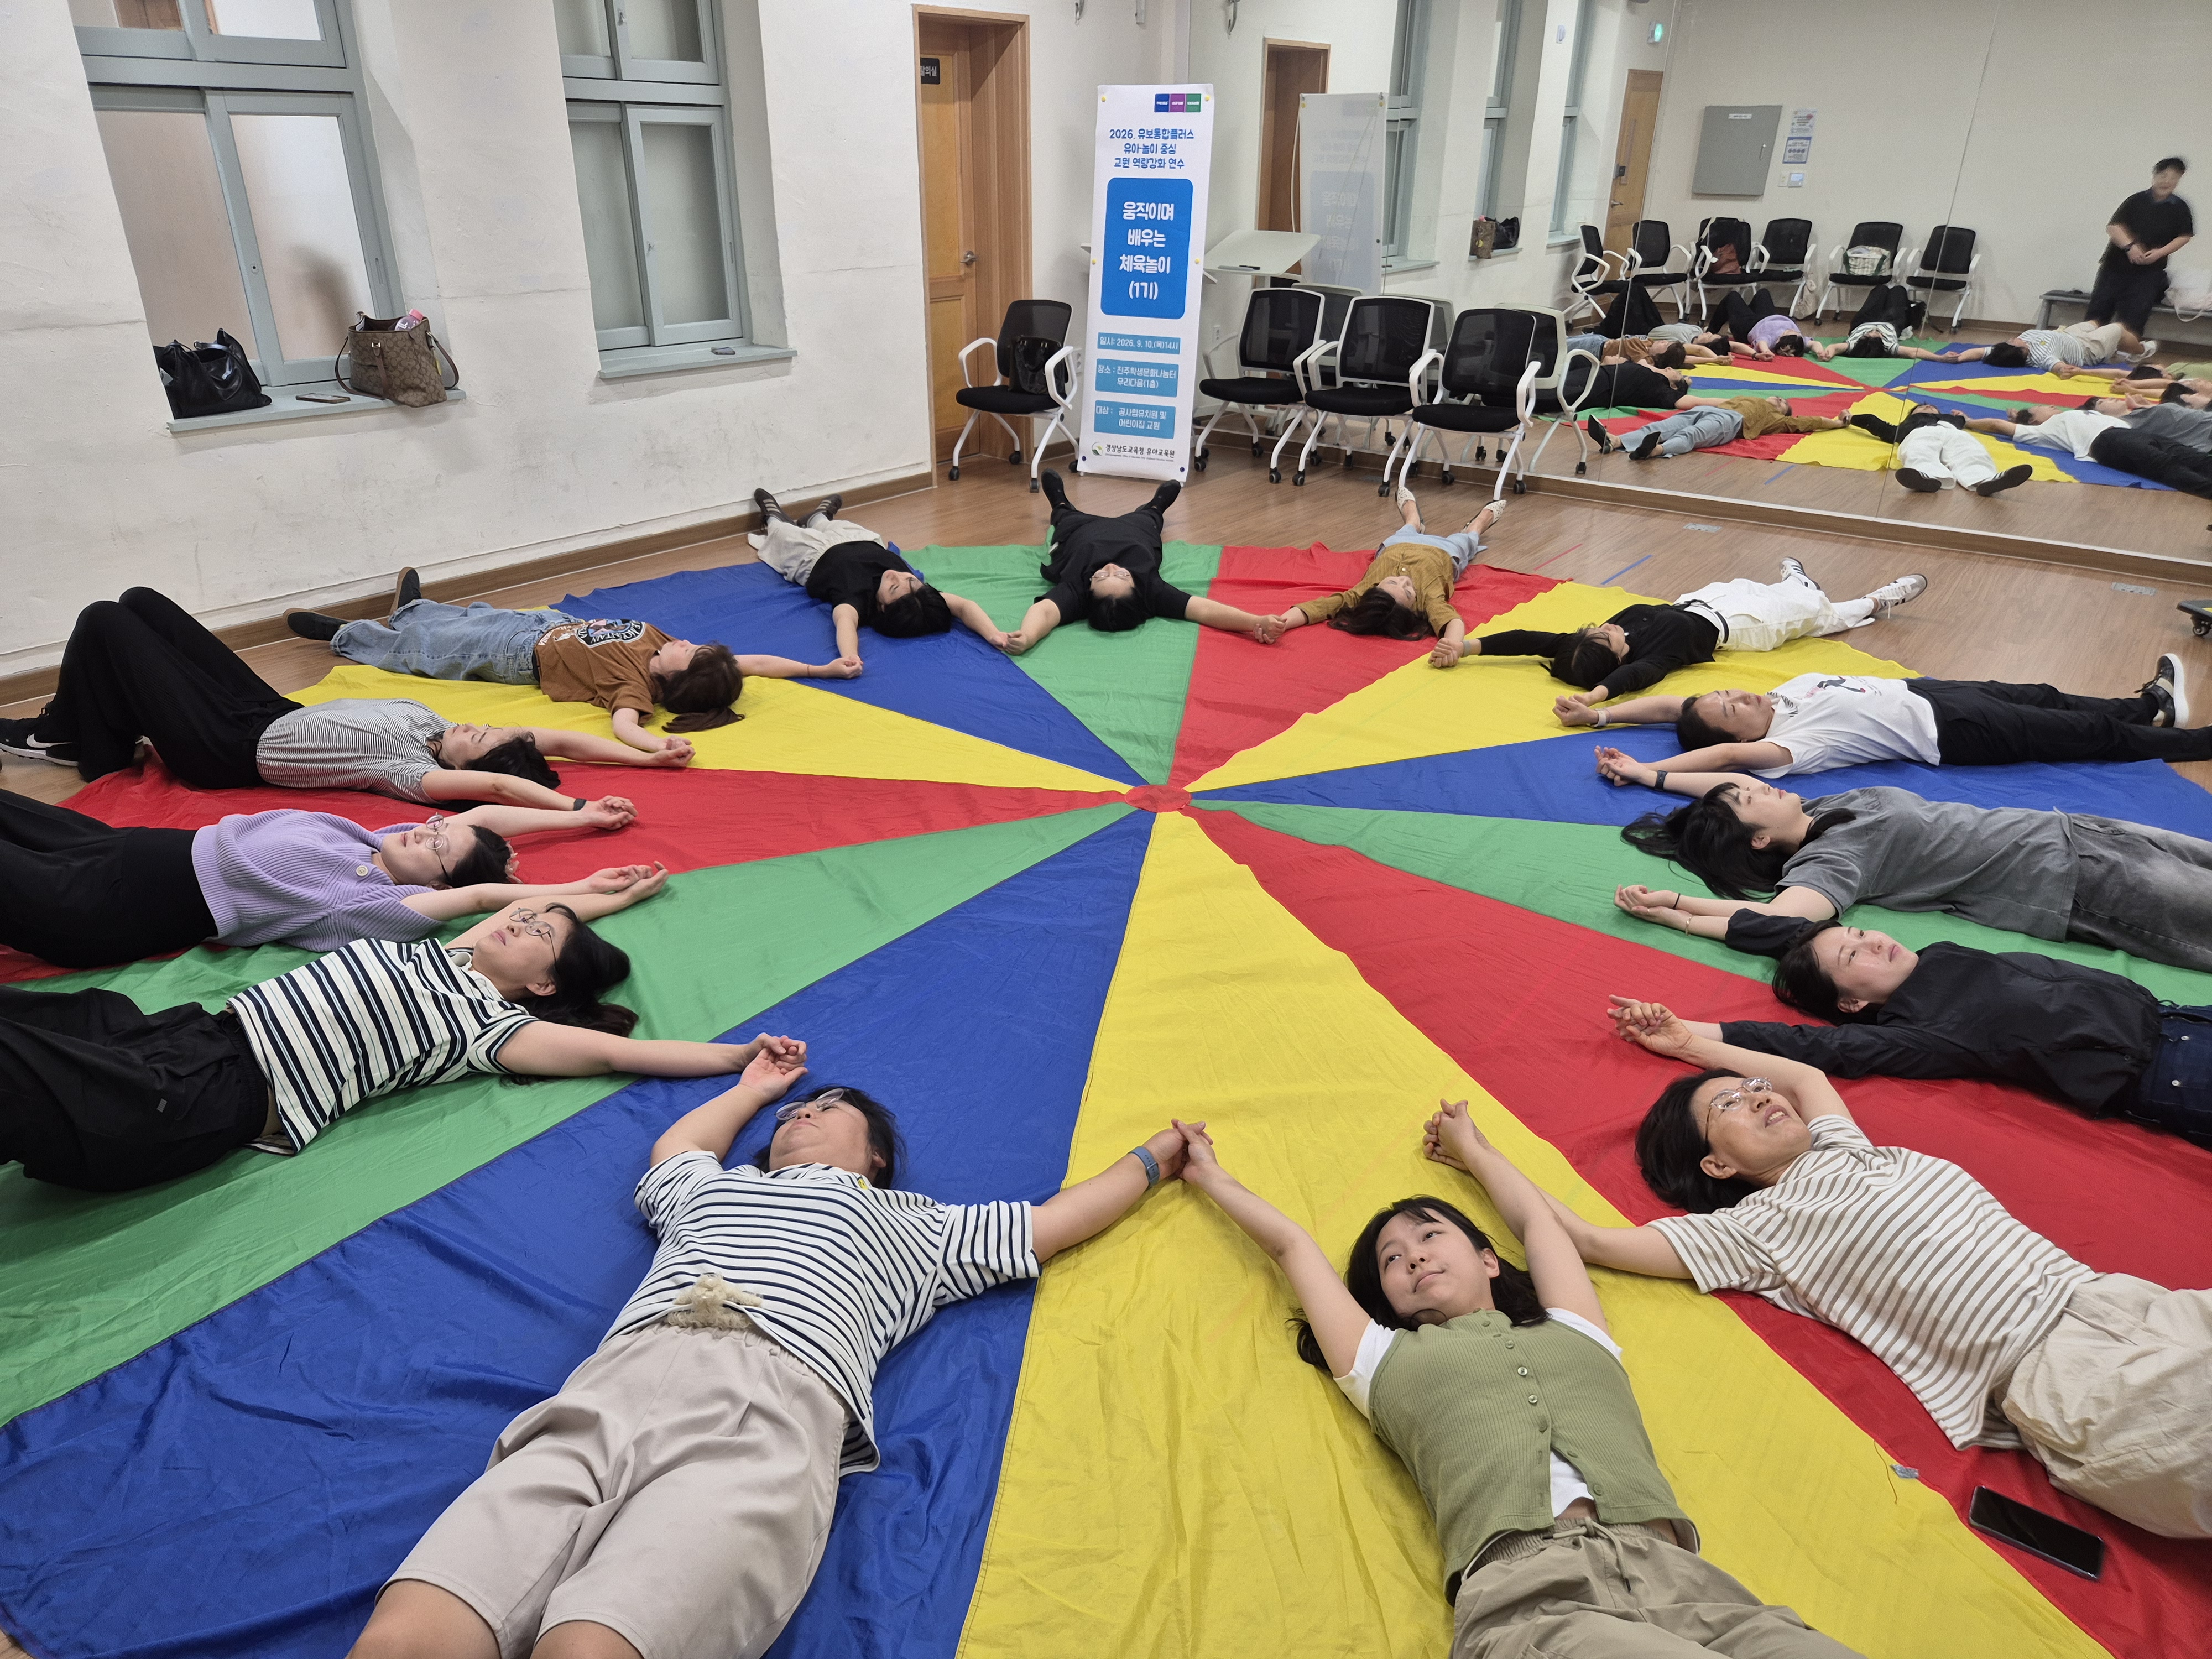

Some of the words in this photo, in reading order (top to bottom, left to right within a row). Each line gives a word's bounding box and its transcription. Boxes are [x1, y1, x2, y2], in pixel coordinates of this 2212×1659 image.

[1109, 129, 1135, 139] 2026.
[1138, 128, 1194, 140] 유보통합플러스
[1160, 143, 1176, 154] 중심
[1114, 157, 1130, 168] 교원
[1133, 158, 1166, 169] 역량강화
[1168, 158, 1185, 169] 연수
[1123, 201, 1174, 221] 움직이며
[1127, 229, 1166, 247] 배우는
[1119, 254, 1171, 274] 체육놀이
[1129, 280, 1158, 300] (1기)
[1117, 338, 1135, 347] 2026.
[1136, 340, 1142, 348] 9.
[1098, 365, 1111, 374] 장소
[1117, 366, 1176, 379] 진주학생문화나눔터
[1096, 405, 1109, 415] 대상
[1160, 411, 1166, 420] 및
[1119, 419, 1145, 429] 어린이집
[1146, 421, 1160, 430] 교원
[1105, 444, 1144, 455] 경상남도교육청
[1146, 448, 1175, 458] 유아교육원
